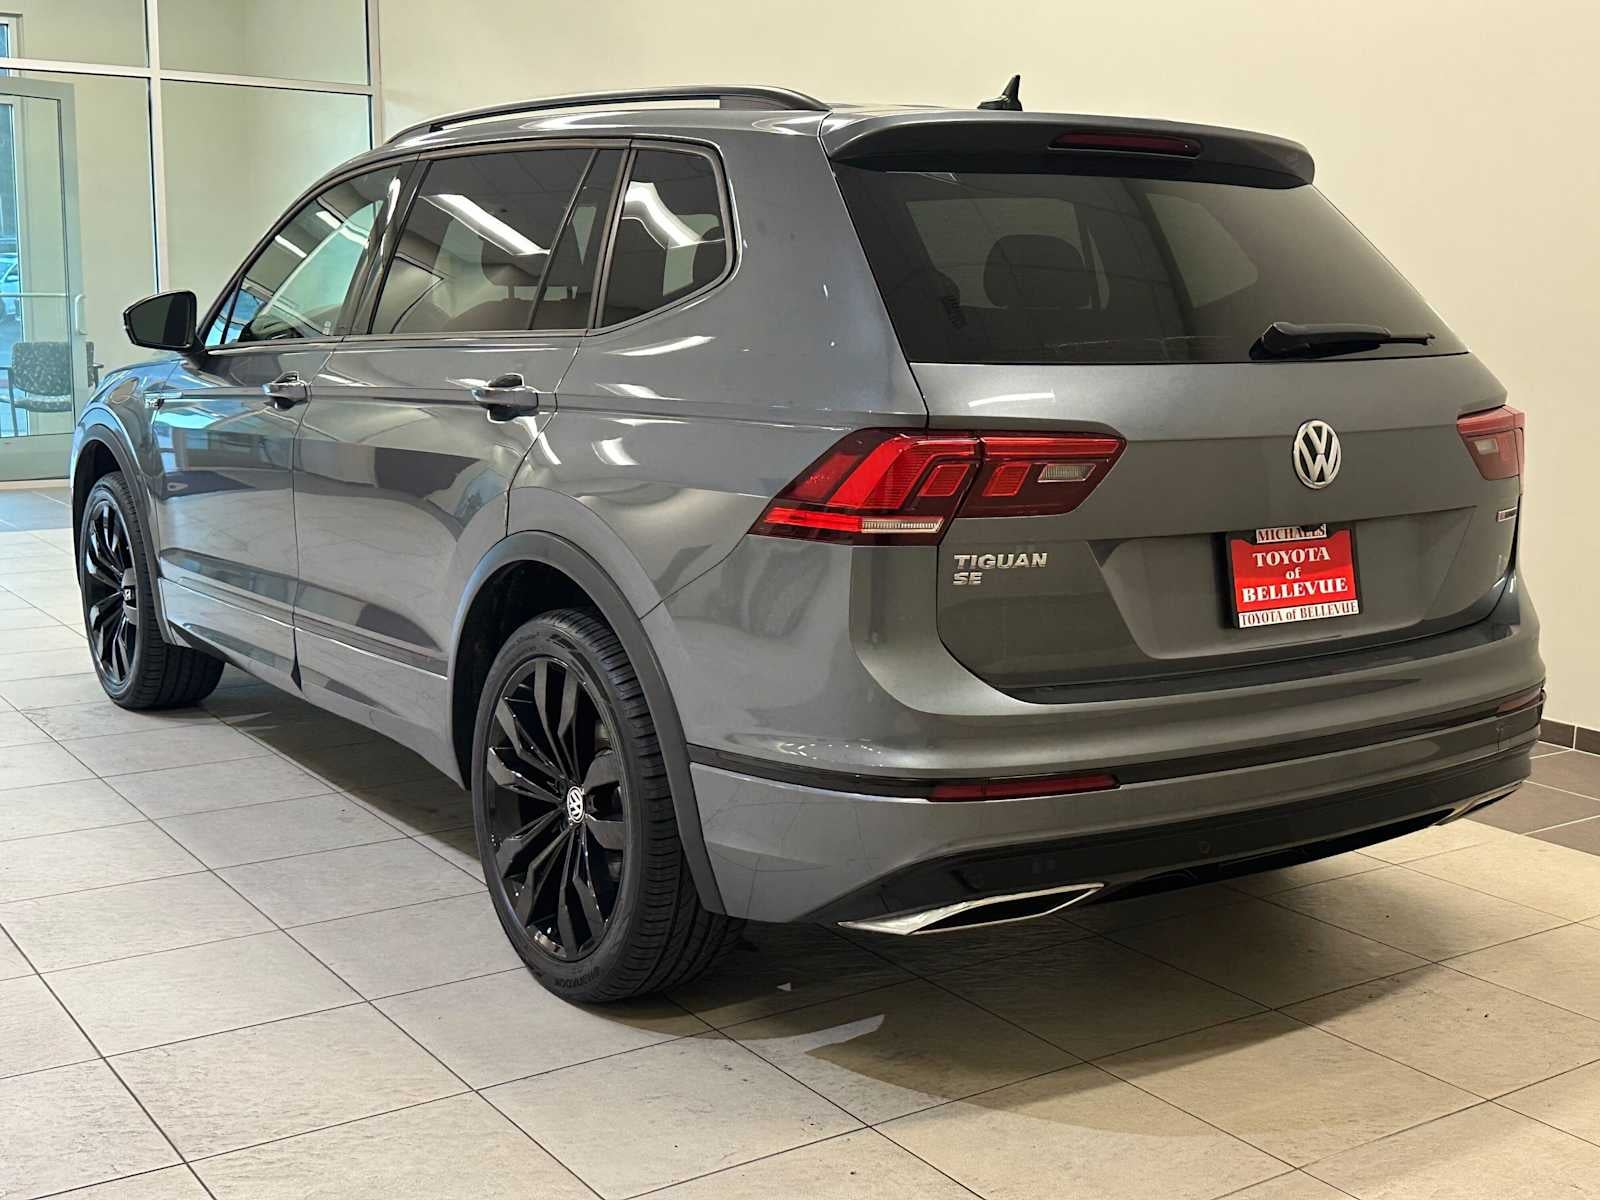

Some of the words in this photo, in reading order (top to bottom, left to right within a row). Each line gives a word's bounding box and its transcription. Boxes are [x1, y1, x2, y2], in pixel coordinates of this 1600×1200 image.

[953, 553, 1047, 569] TIGUAN
[1252, 547, 1331, 567] TOYOTA
[953, 572, 982, 585] SE
[1285, 567, 1302, 580] of
[1242, 578, 1348, 603] BELLEVUE
[1241, 611, 1283, 625] TOYOTA
[1286, 610, 1297, 620] of
[1300, 602, 1357, 618] BELLEVUE
